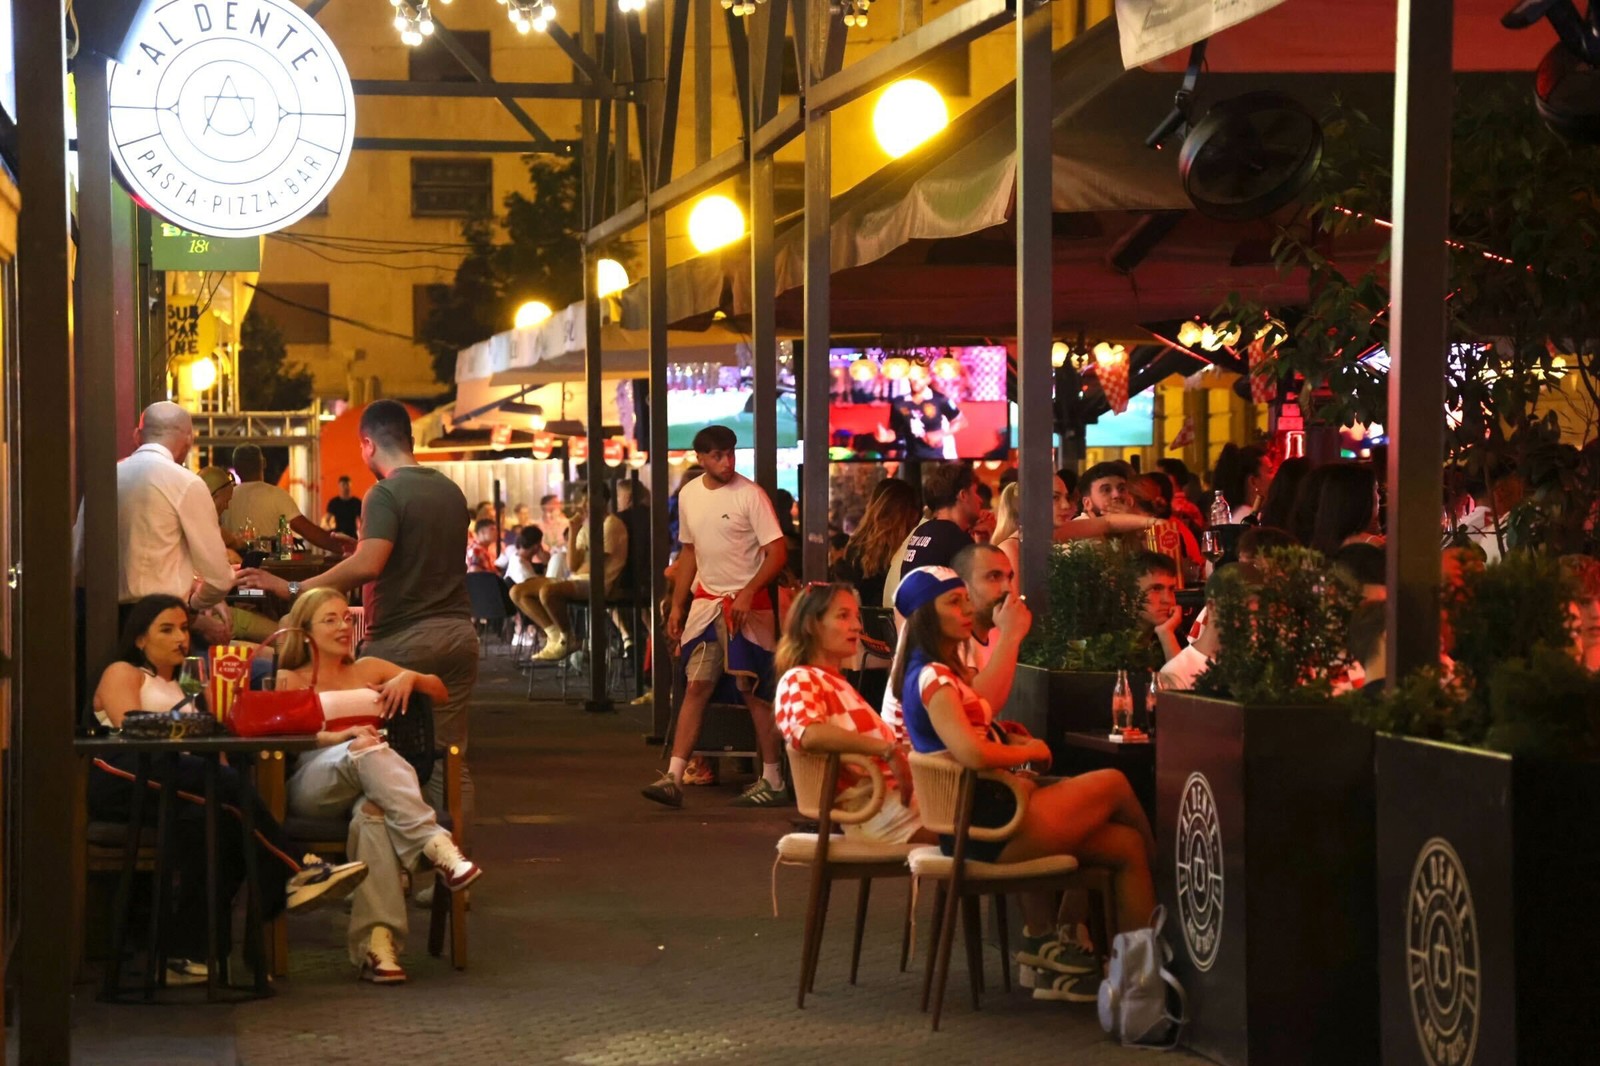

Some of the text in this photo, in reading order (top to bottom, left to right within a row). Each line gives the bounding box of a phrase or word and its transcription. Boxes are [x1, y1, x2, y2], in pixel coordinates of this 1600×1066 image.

[193, 1, 319, 72] DENTE
[137, 149, 322, 215] PASTA PIZZA BAR
